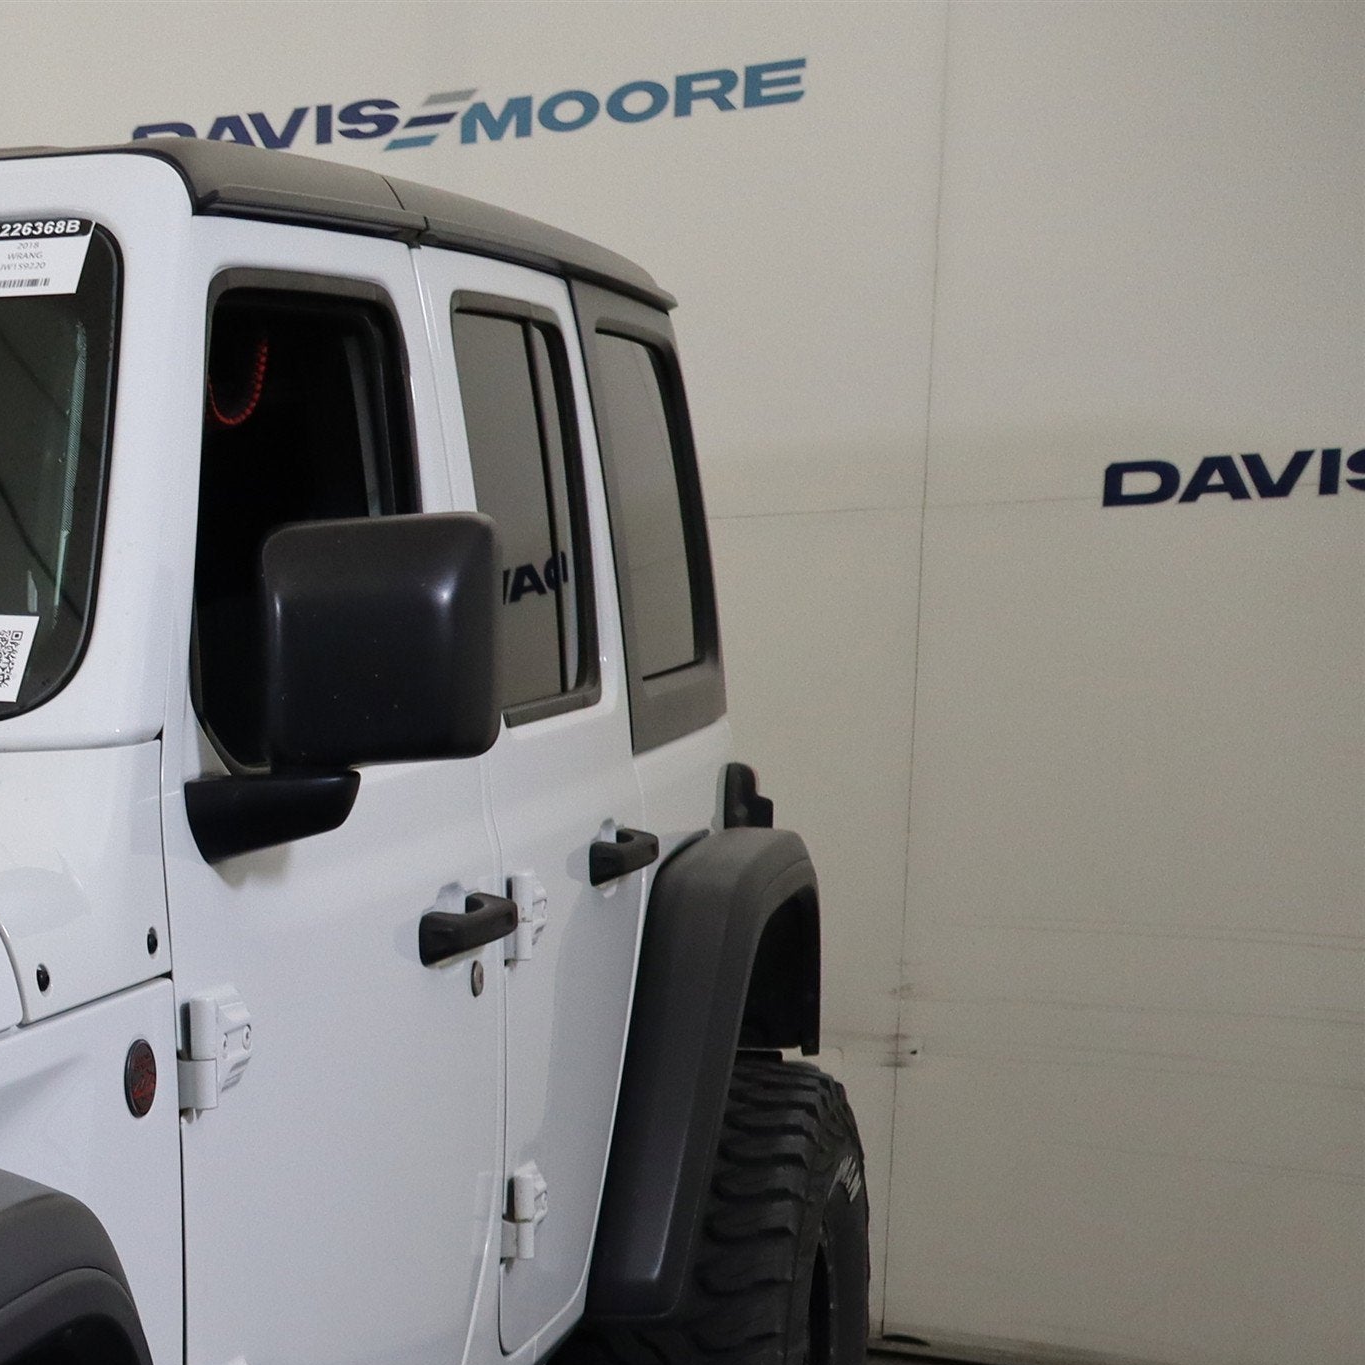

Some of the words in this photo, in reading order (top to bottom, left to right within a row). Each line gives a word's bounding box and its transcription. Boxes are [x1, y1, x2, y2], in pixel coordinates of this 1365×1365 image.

[460, 58, 807, 145] MOORE
[17, 241, 40, 250] 2018
[7, 251, 44, 260] WRANG
